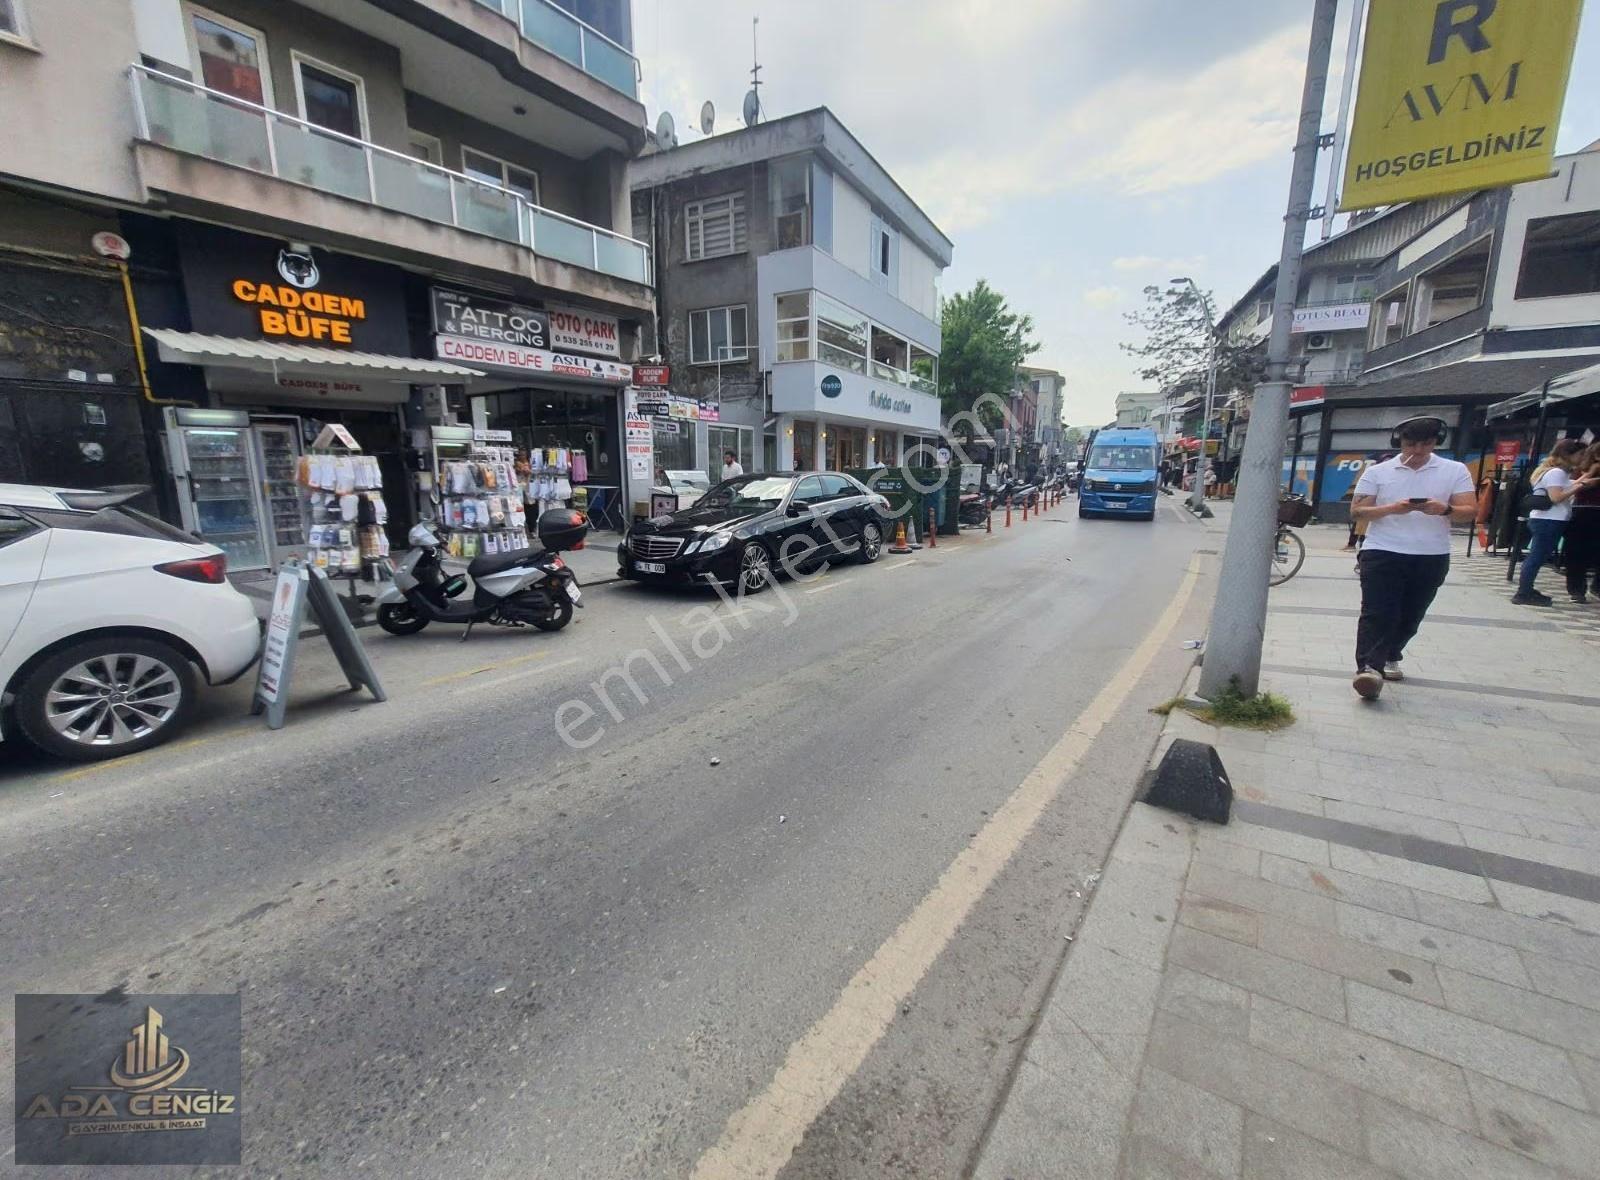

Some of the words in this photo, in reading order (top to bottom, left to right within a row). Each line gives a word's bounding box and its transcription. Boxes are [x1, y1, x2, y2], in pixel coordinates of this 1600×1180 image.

[1426, 0, 1497, 66] R
[1383, 61, 1523, 130] AVM
[1355, 125, 1547, 183] HOŞGELDİNİZ
[233, 279, 366, 319] CADDEM
[260, 307, 352, 344] BÜFE
[443, 303, 542, 333] TATTOO
[445, 320, 457, 333] &
[460, 322, 545, 347] PIERCING
[549, 311, 582, 333] FOTO
[584, 318, 616, 341] ÇARK
[443, 340, 505, 364] CADDEM
[555, 334, 561, 342] 0
